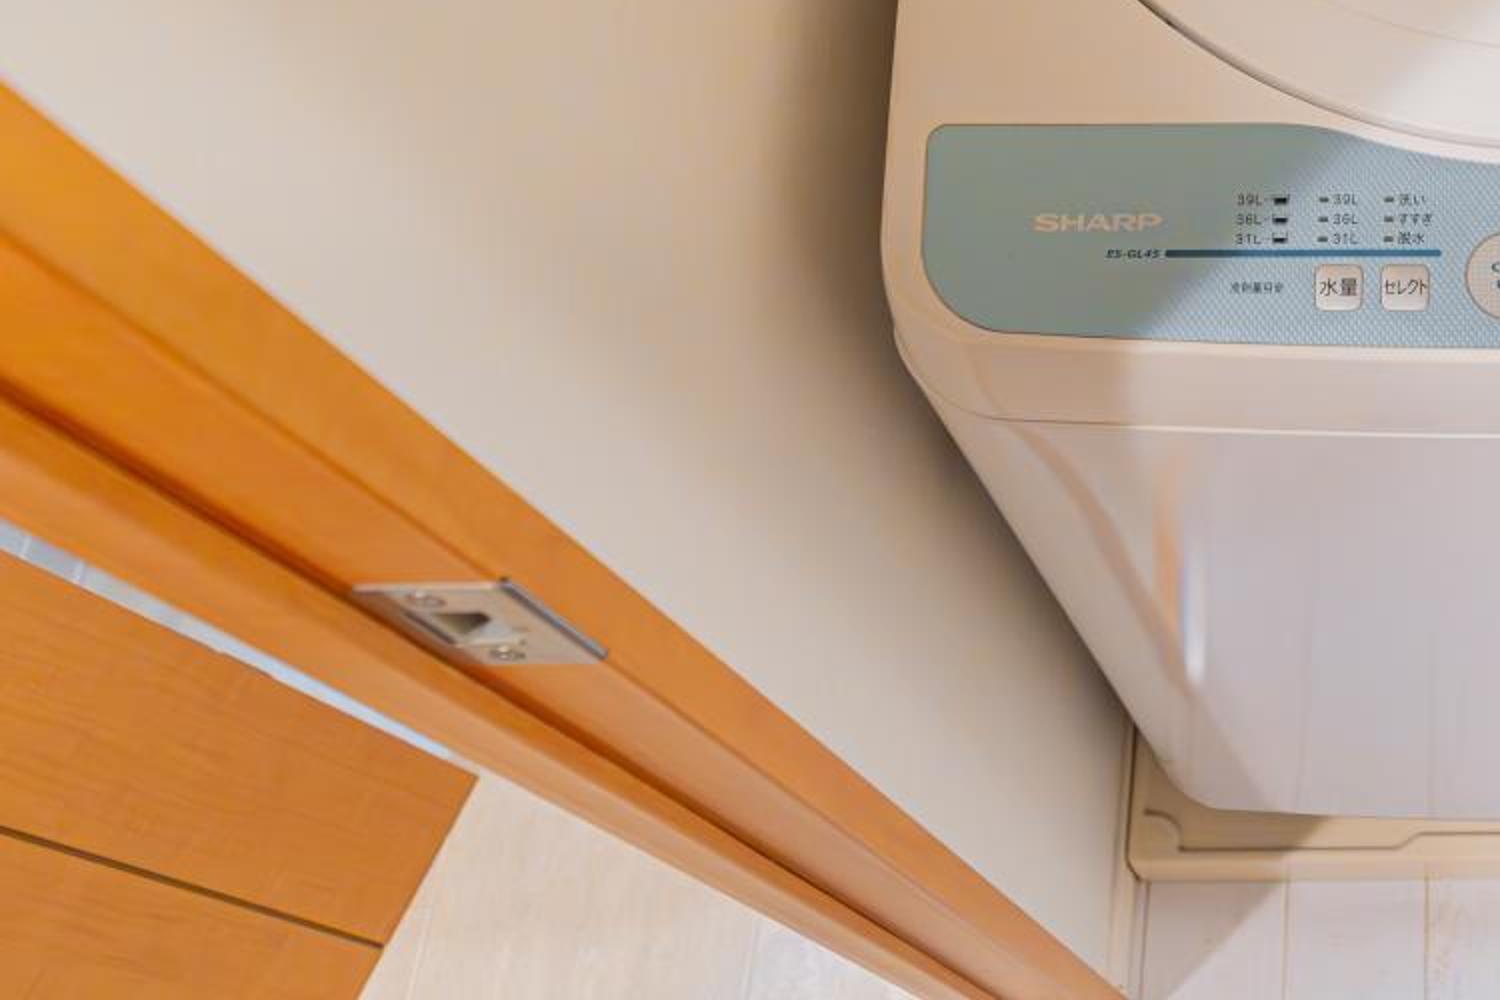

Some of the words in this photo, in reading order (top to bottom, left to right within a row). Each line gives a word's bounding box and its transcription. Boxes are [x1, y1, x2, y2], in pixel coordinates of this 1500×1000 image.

[1032, 213, 1164, 232] SHARP
[1319, 277, 1358, 297] 水量
[1384, 279, 1428, 296] セレクト
